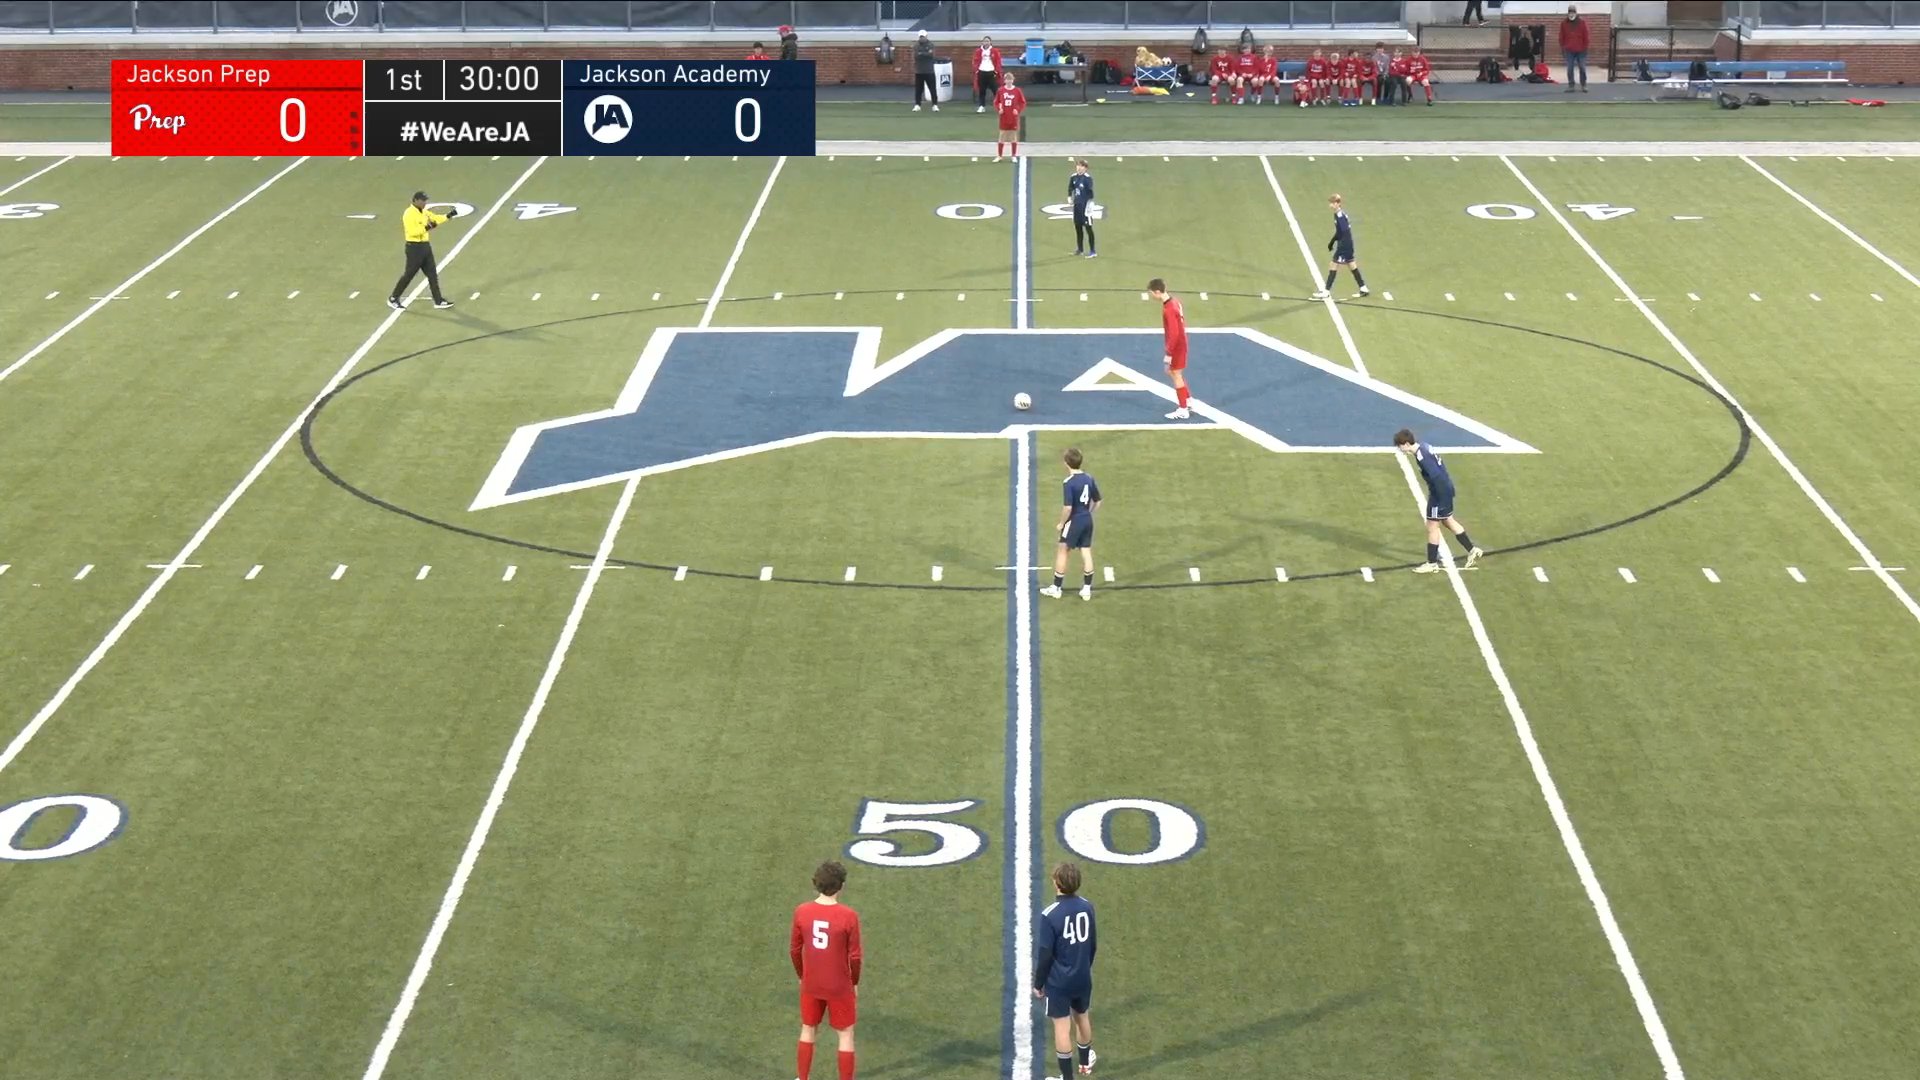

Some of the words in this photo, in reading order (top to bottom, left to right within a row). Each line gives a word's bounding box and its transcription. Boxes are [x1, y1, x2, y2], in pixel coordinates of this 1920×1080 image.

[1079, 484, 1090, 505] 4
[811, 919, 830, 950] 5
[1062, 911, 1091, 945] 40
